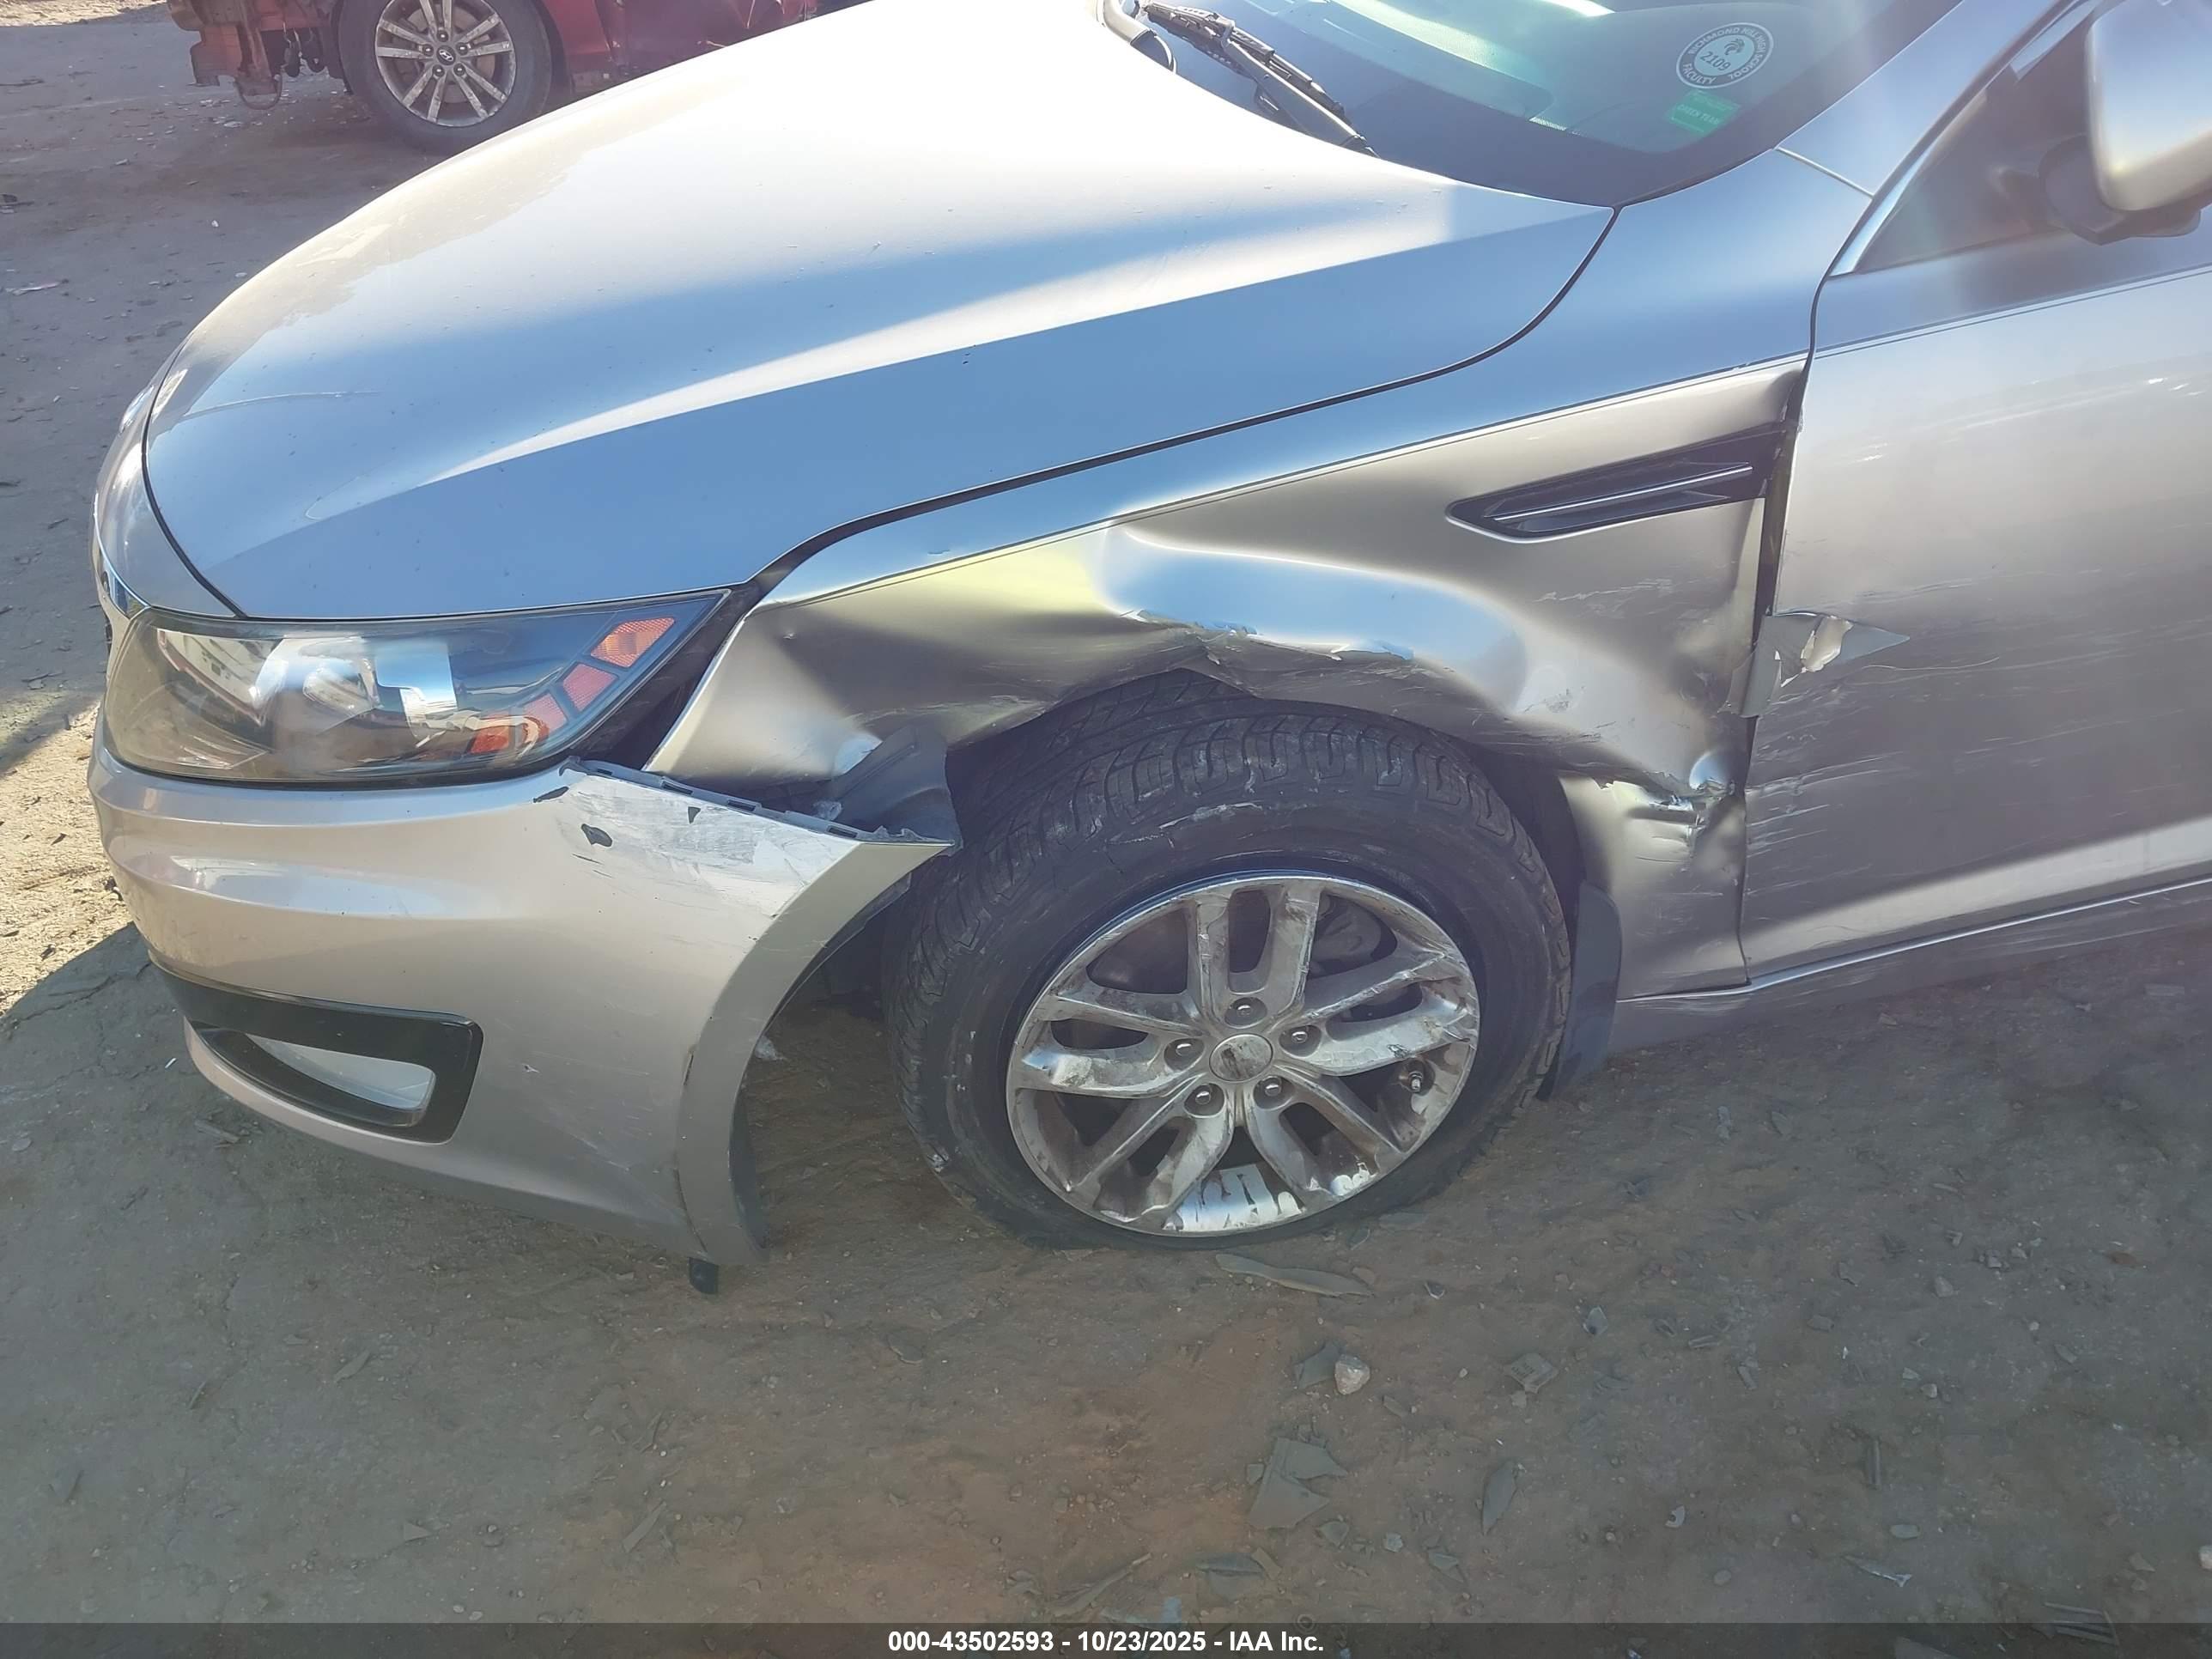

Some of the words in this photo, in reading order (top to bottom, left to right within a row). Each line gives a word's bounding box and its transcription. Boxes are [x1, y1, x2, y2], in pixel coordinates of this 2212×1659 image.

[1688, 27, 1740, 54] RICHMOND
[1727, 54, 1763, 79] SCHOOL
[1699, 51, 1731, 70] 2109
[1682, 63, 1717, 84] FACULTY
